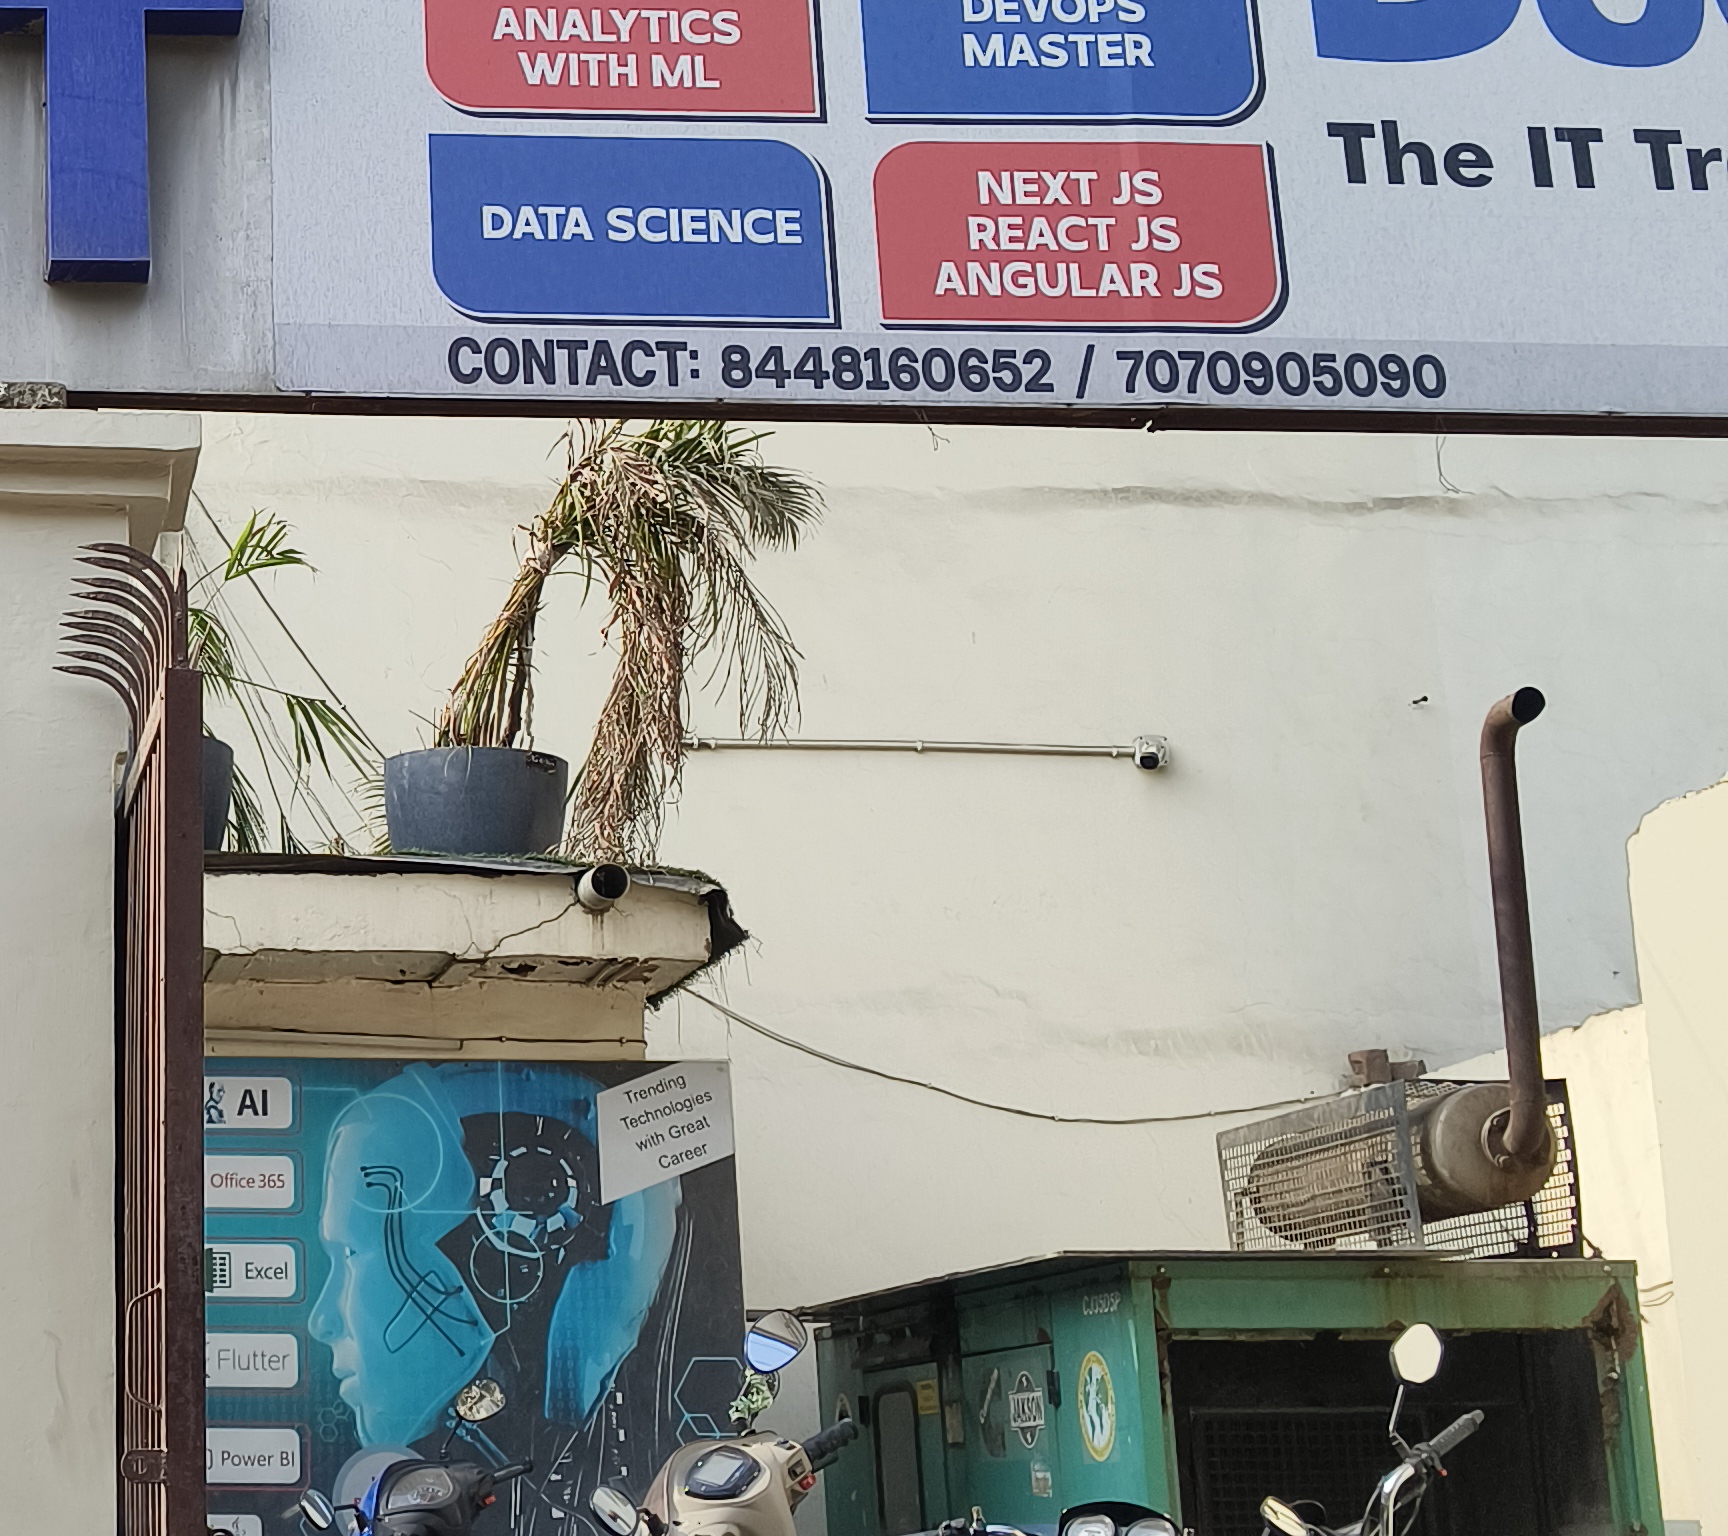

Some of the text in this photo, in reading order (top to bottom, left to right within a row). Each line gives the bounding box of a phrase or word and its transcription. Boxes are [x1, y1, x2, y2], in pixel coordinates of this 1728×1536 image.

[493, 8, 742, 45] ANALYTICS
[962, 32, 1155, 67] MASTER
[518, 52, 720, 89] WITH ML
[1326, 119, 1728, 192] The IT Tr
[977, 170, 1162, 206] NEXT JS
[481, 205, 803, 245] DATA SCIENCE
[967, 216, 1182, 251] REACT JS
[934, 262, 1223, 299] ANGULAR JS
[448, 337, 701, 390] CONTACT:
[721, 344, 1055, 394] 8448160652
[1116, 348, 1447, 398] 7070905090
[237, 1089, 268, 1116] AI
[624, 1075, 687, 1104] Trending
[620, 1091, 713, 1130] Technologies
[635, 1115, 711, 1152] with Great
[658, 1143, 708, 1169] Career
[210, 1171, 285, 1189] Office 365
[245, 1261, 288, 1280] Excel
[217, 1348, 291, 1371] Flutter
[221, 1450, 295, 1468] Power BI
